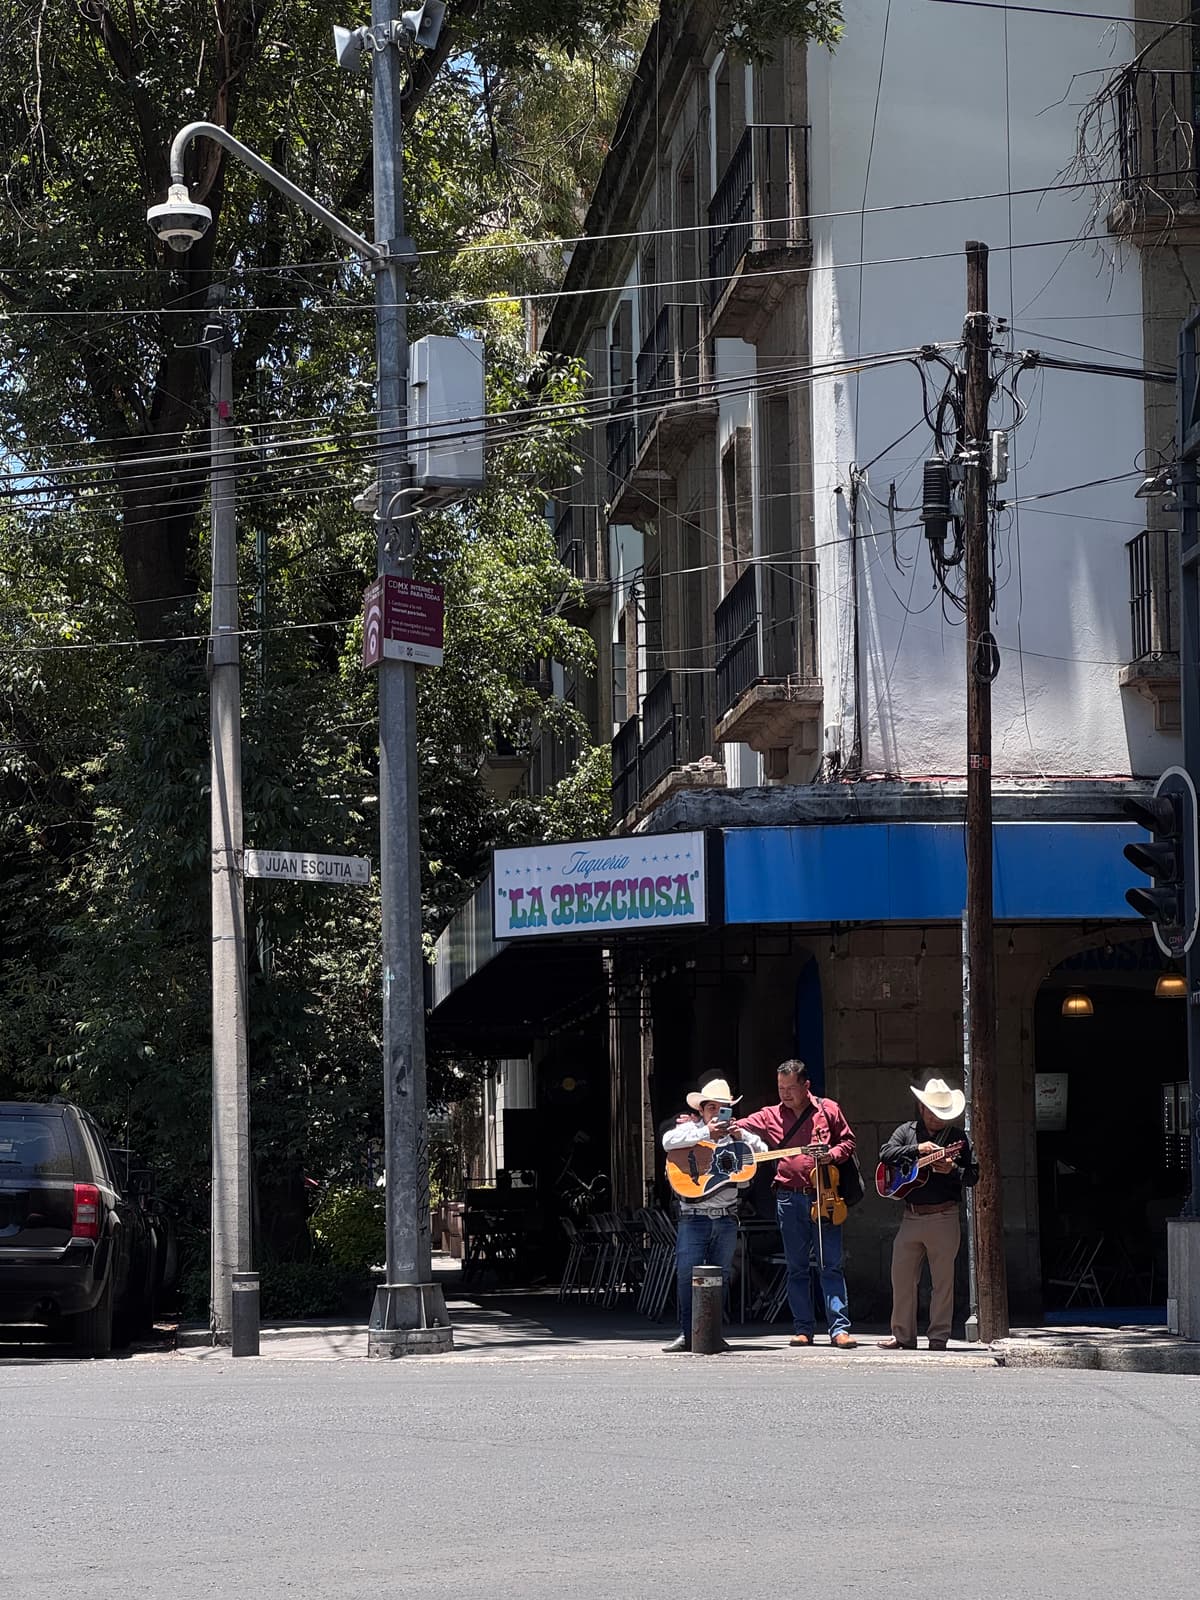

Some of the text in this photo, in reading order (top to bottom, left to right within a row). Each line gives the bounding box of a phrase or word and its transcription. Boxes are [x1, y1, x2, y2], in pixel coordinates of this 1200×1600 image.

[388, 580, 408, 590] CDMX
[265, 857, 297, 873] JUAN
[301, 859, 352, 877] ESCUTIA
